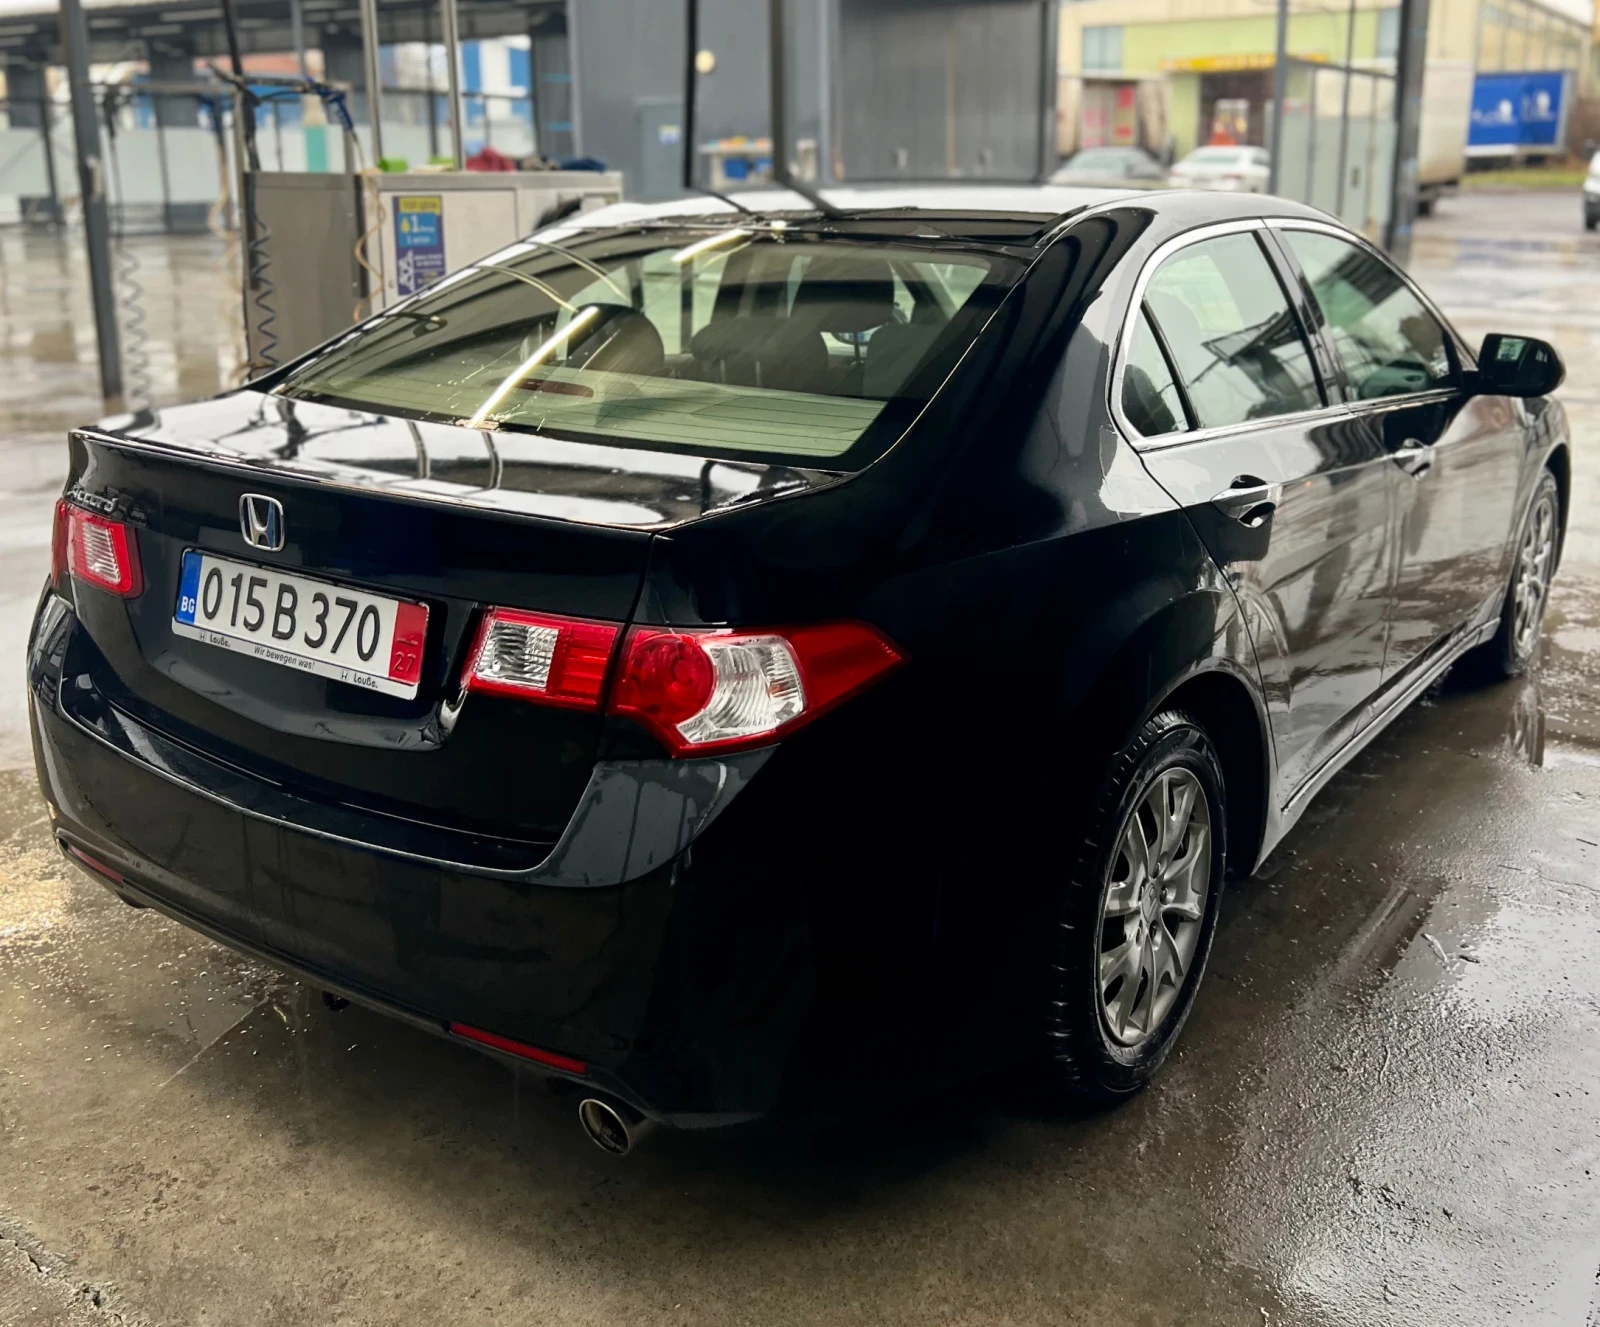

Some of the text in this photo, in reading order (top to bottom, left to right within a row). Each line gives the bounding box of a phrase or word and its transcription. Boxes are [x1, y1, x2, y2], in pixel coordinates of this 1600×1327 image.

[181, 596, 195, 613] BG
[203, 567, 380, 661] 015B370
[254, 645, 316, 670] Wir bewegen was!
[394, 651, 416, 672] 27
